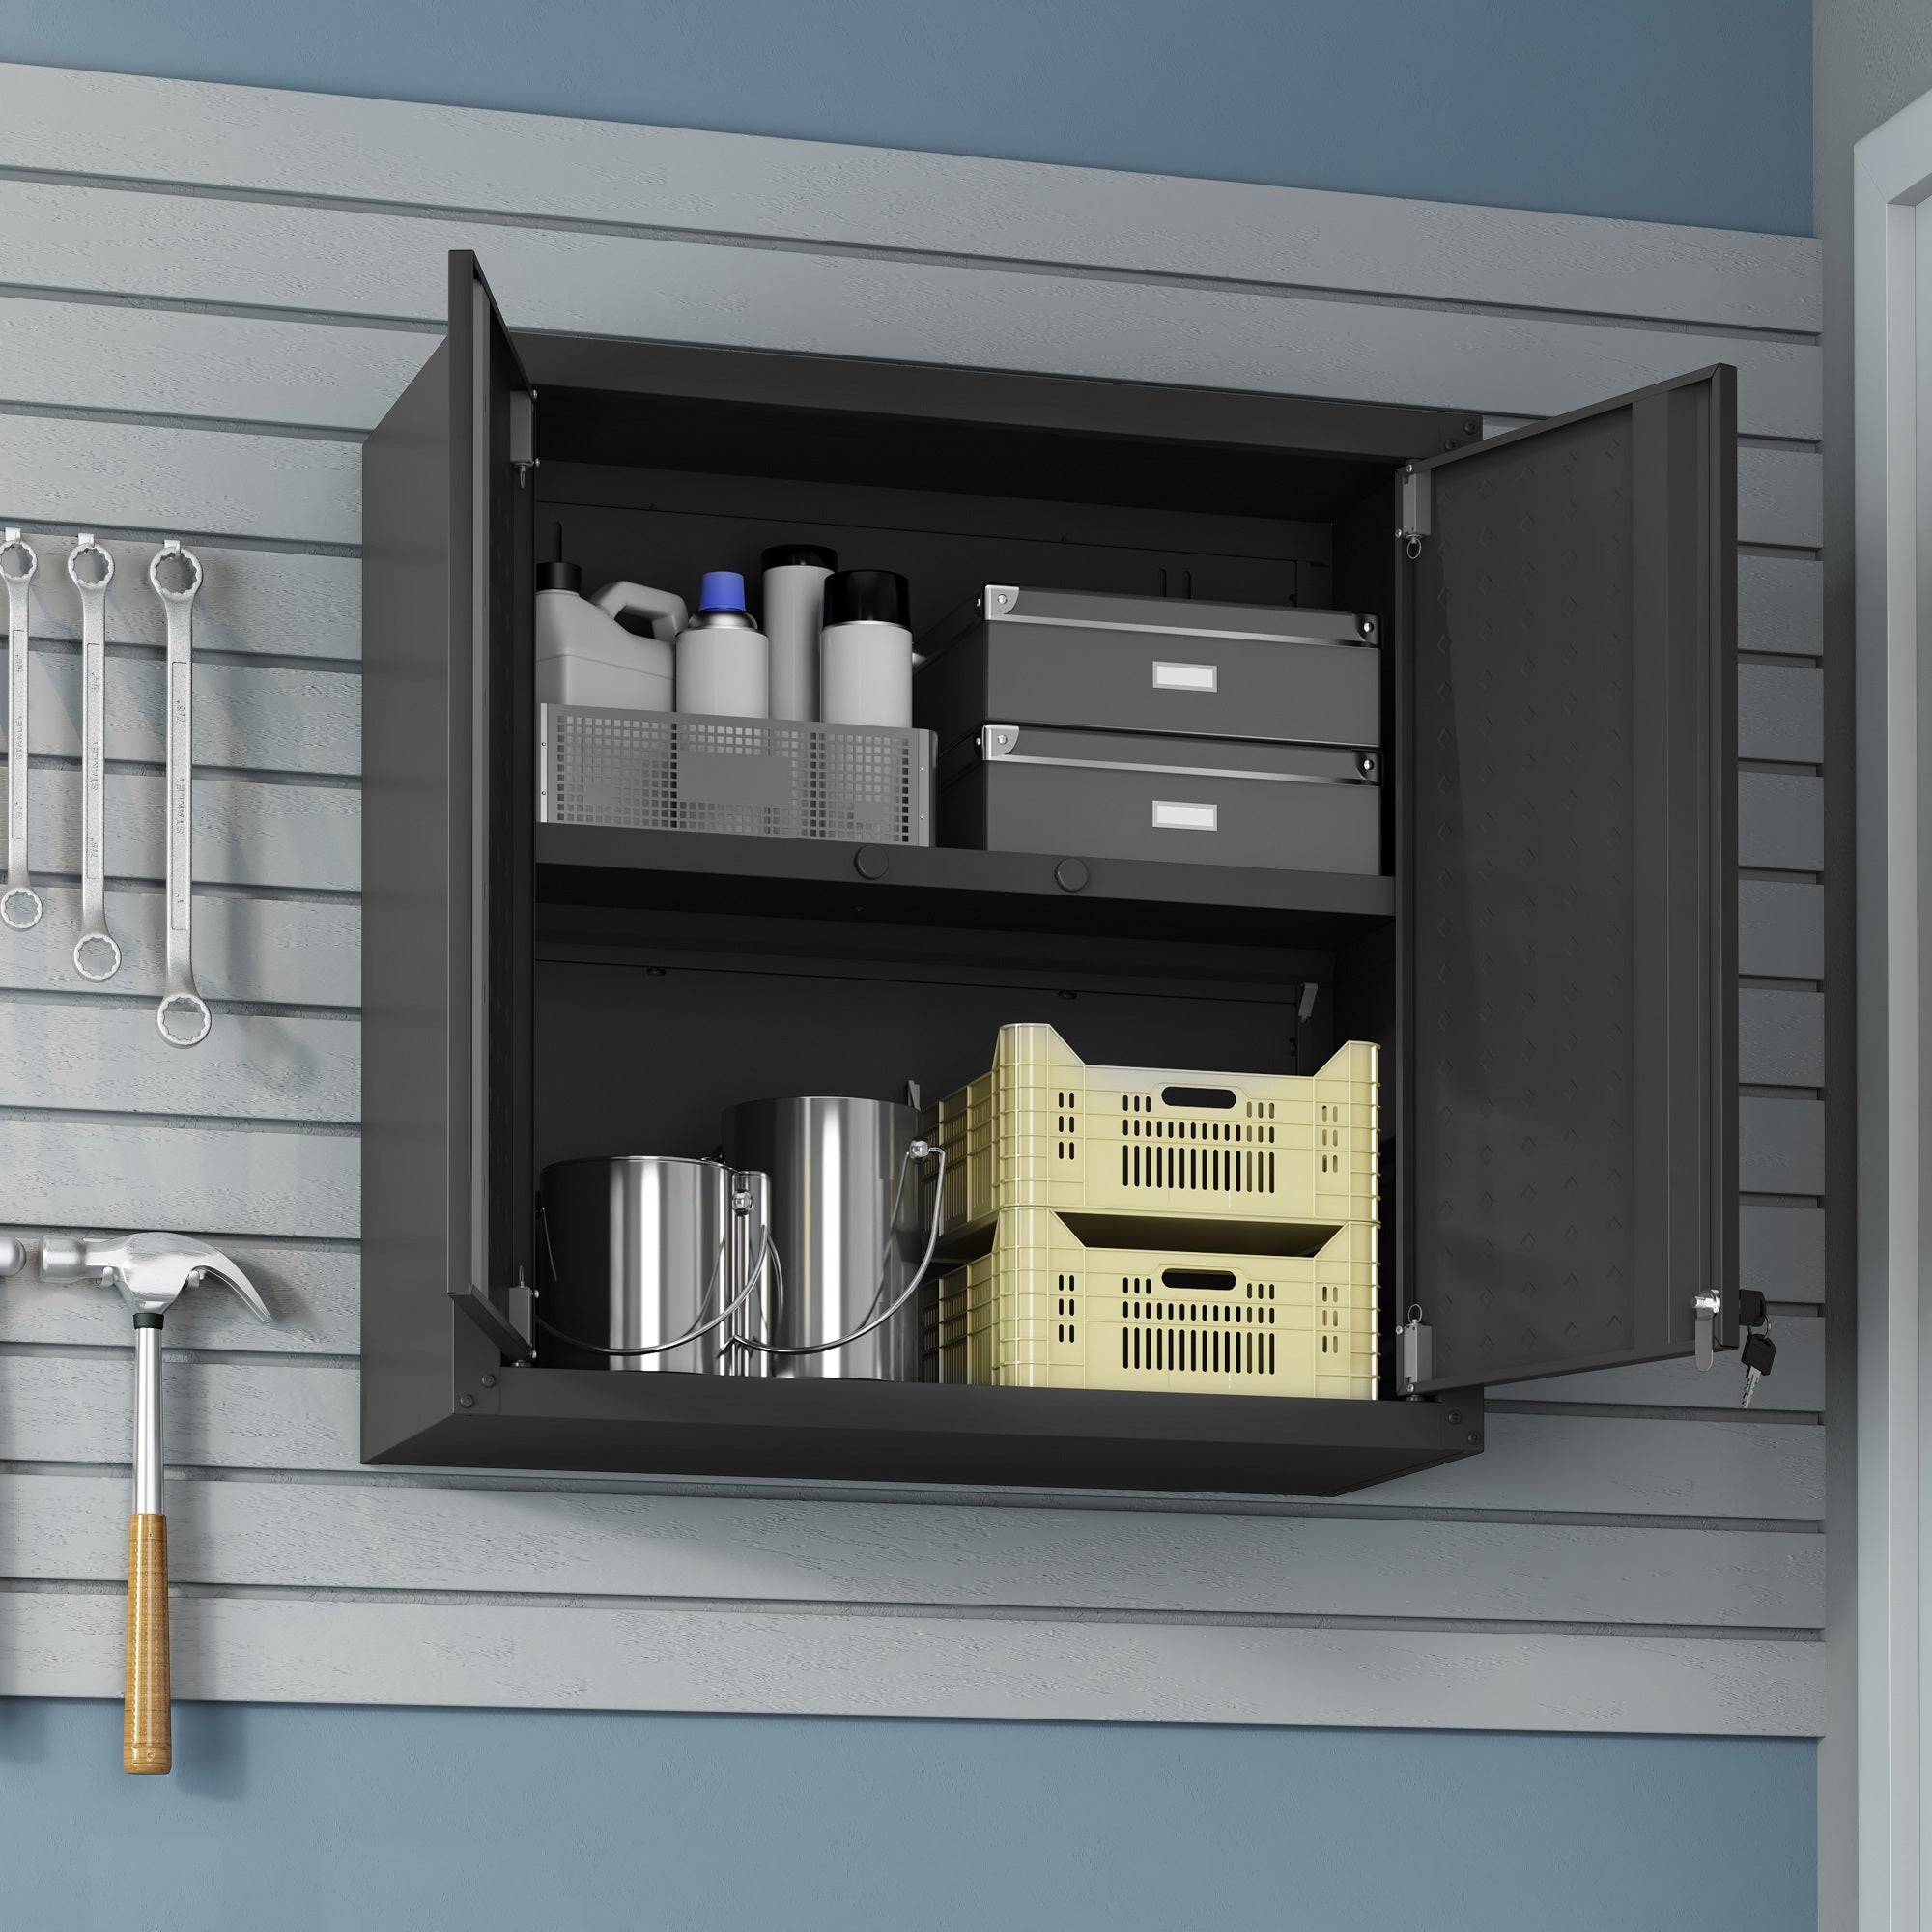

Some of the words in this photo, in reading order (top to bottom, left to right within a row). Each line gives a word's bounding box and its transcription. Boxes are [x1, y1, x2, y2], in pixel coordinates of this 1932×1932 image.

[14, 716, 23, 760] STANLEY
[90, 741, 99, 791] STANLEY
[176, 777, 185, 834] STANLEY
